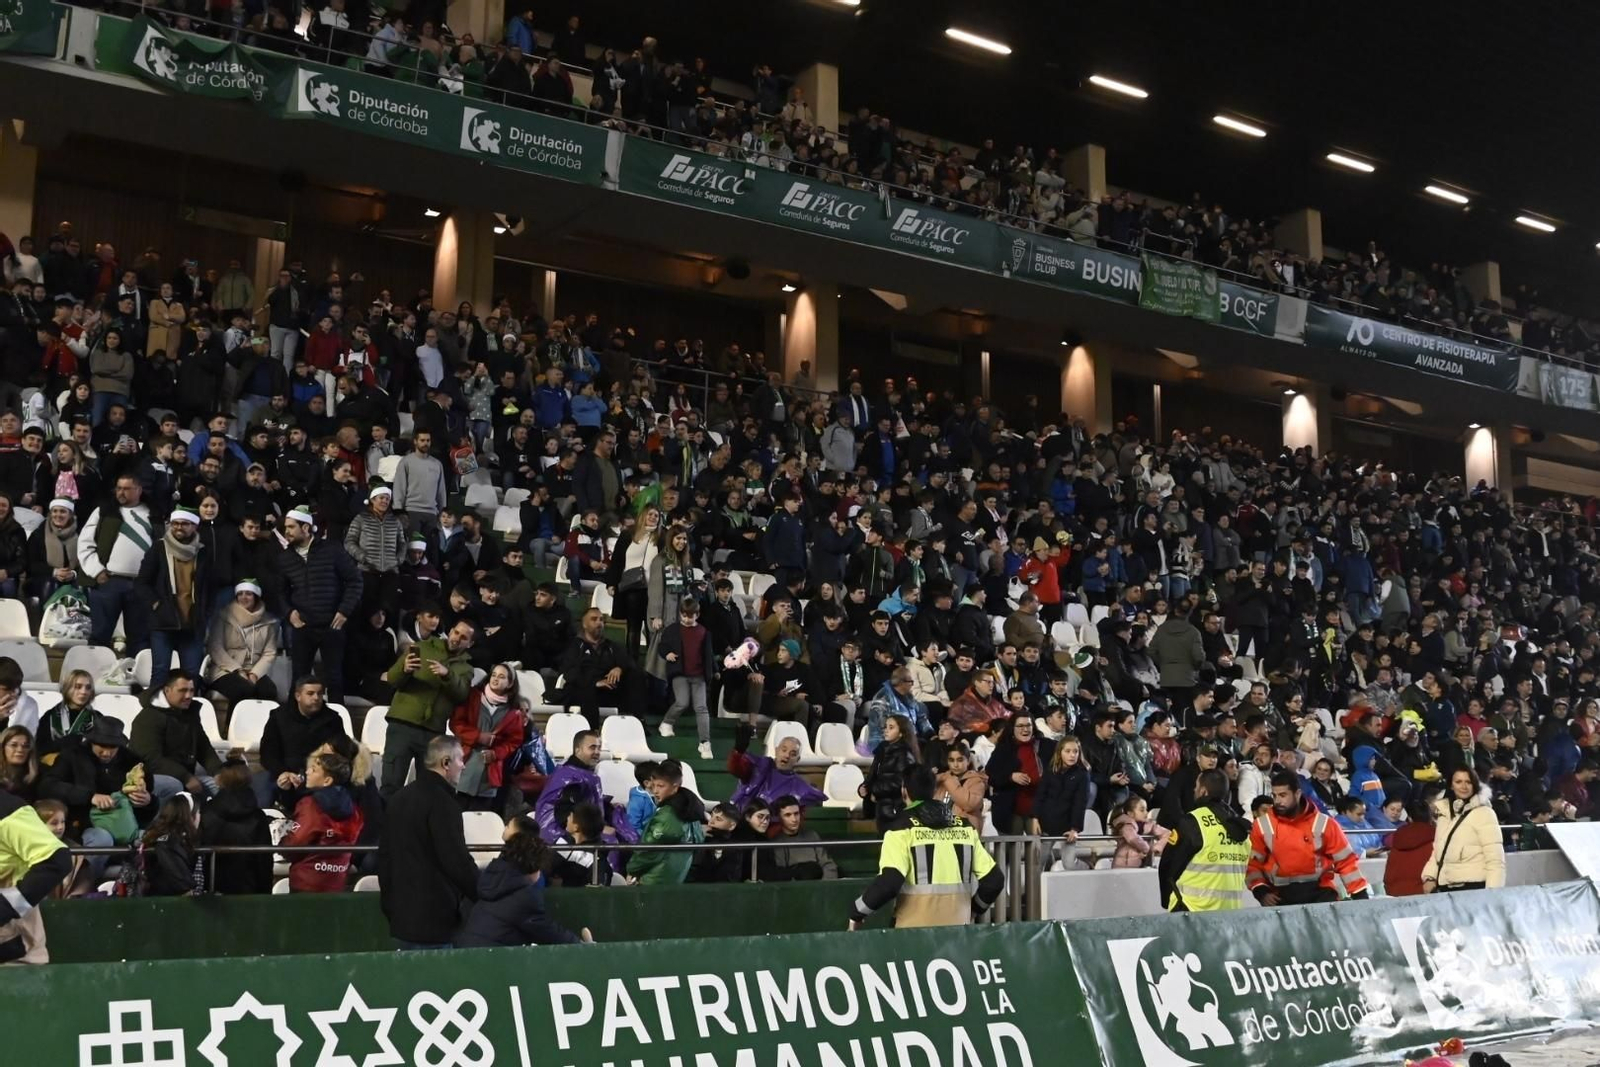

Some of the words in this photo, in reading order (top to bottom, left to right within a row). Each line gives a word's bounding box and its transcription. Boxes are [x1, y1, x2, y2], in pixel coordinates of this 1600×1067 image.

[185, 72, 206, 86] de
[349, 89, 429, 120] Diputación
[347, 107, 366, 122] de
[370, 110, 428, 136] Córdoba
[509, 126, 583, 155] Diputación
[507, 143, 525, 158] de
[528, 146, 582, 170] Córdoba
[689, 167, 746, 196] PACC
[693, 189, 703, 199] de
[704, 190, 735, 206] Seguros
[808, 195, 867, 222] PACC
[813, 215, 821, 224] de
[822, 216, 851, 230] Seguros
[916, 220, 971, 246] PACC
[929, 240, 955, 254] Seguros
[1034, 263, 1057, 276] CLUB
[1035, 252, 1076, 271] BUSINESS
[1081, 257, 1143, 293] BUSIN
[1233, 296, 1268, 322] CCF
[1382, 326, 1421, 347] CENTRO
[1422, 336, 1436, 351] DE
[1436, 338, 1496, 366] FISIOTERAPIA
[1414, 352, 1464, 376] AVANZADA
[1559, 375, 1587, 398] 175
[972, 958, 1006, 986] DE
[1224, 949, 1378, 1001] Diputación
[548, 958, 967, 1050] PATRIMONIO
[981, 988, 1016, 1016] LA
[1244, 1006, 1281, 1043] de
